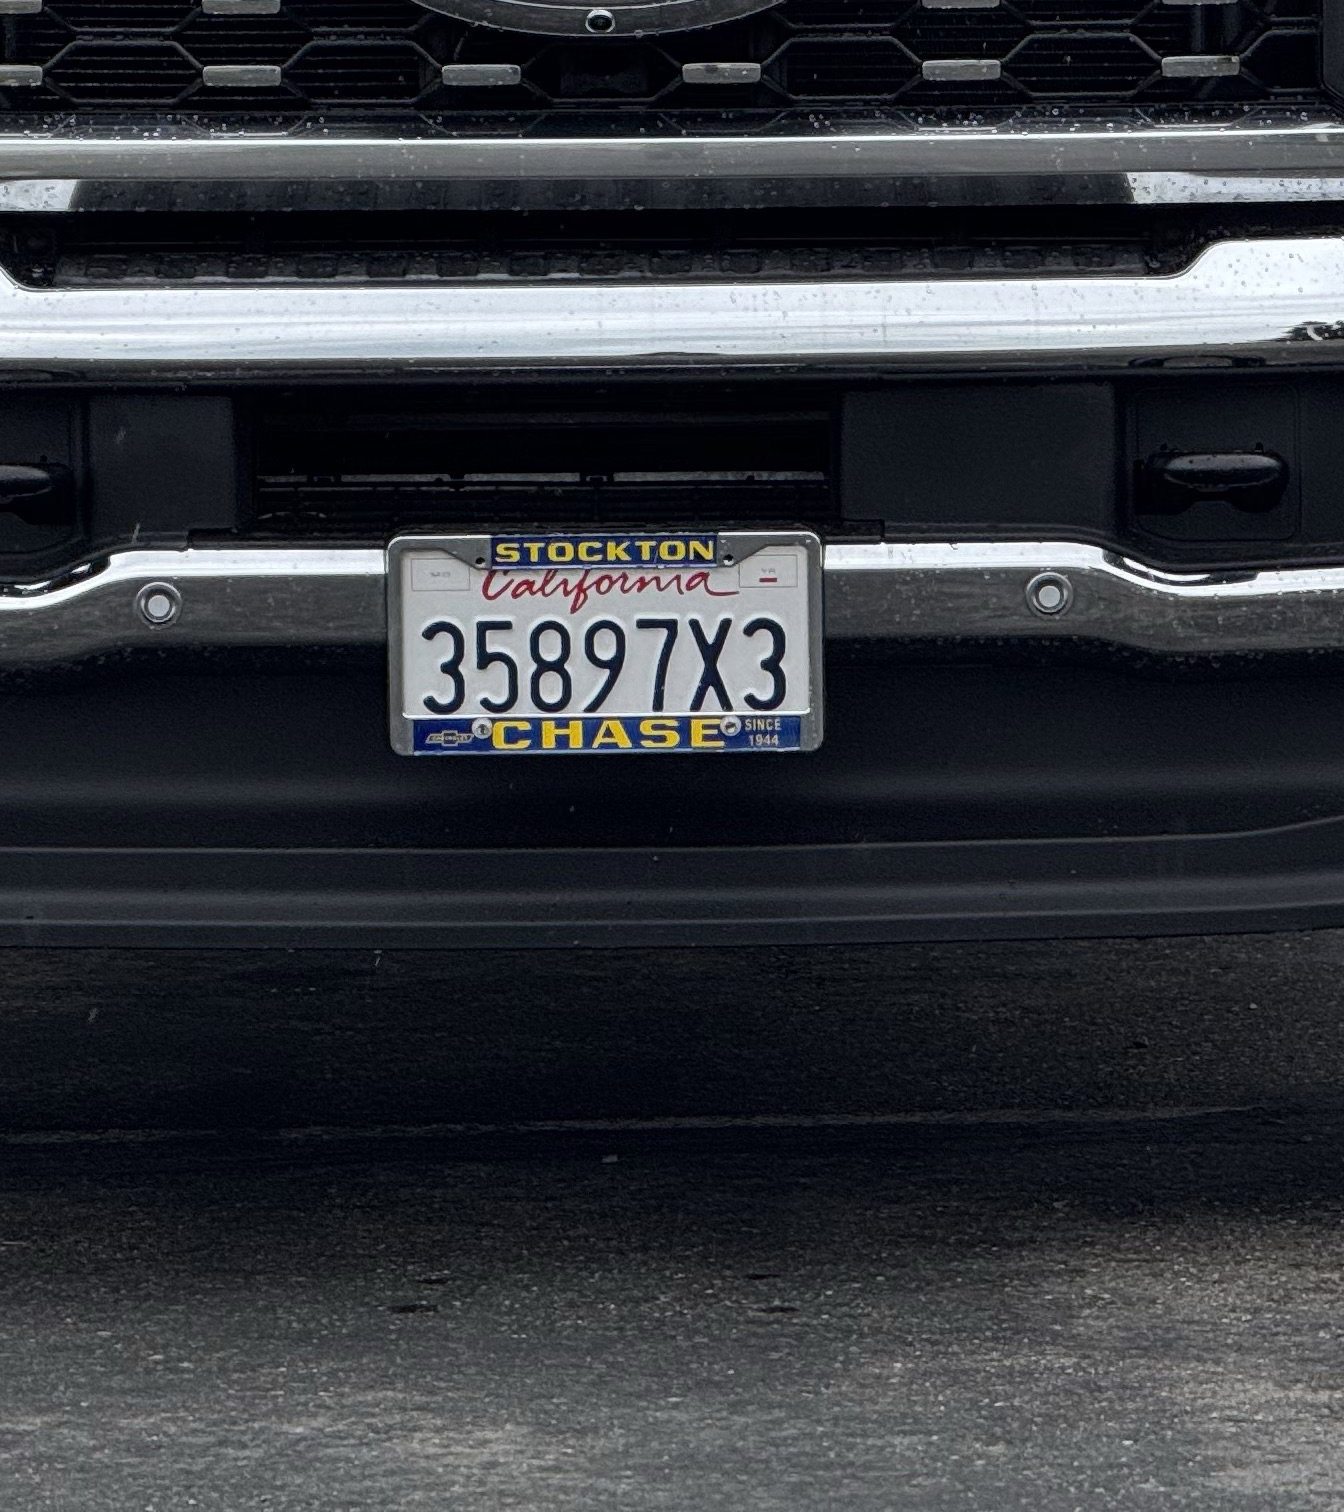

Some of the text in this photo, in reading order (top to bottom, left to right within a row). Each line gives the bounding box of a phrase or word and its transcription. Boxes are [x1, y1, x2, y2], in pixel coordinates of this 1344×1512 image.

[494, 539, 716, 564] STOCKTON
[482, 568, 740, 614] California
[421, 618, 787, 713] 35897X3
[492, 719, 726, 748] CHASE
[744, 718, 782, 731] SINCE
[748, 733, 779, 746] 1944
